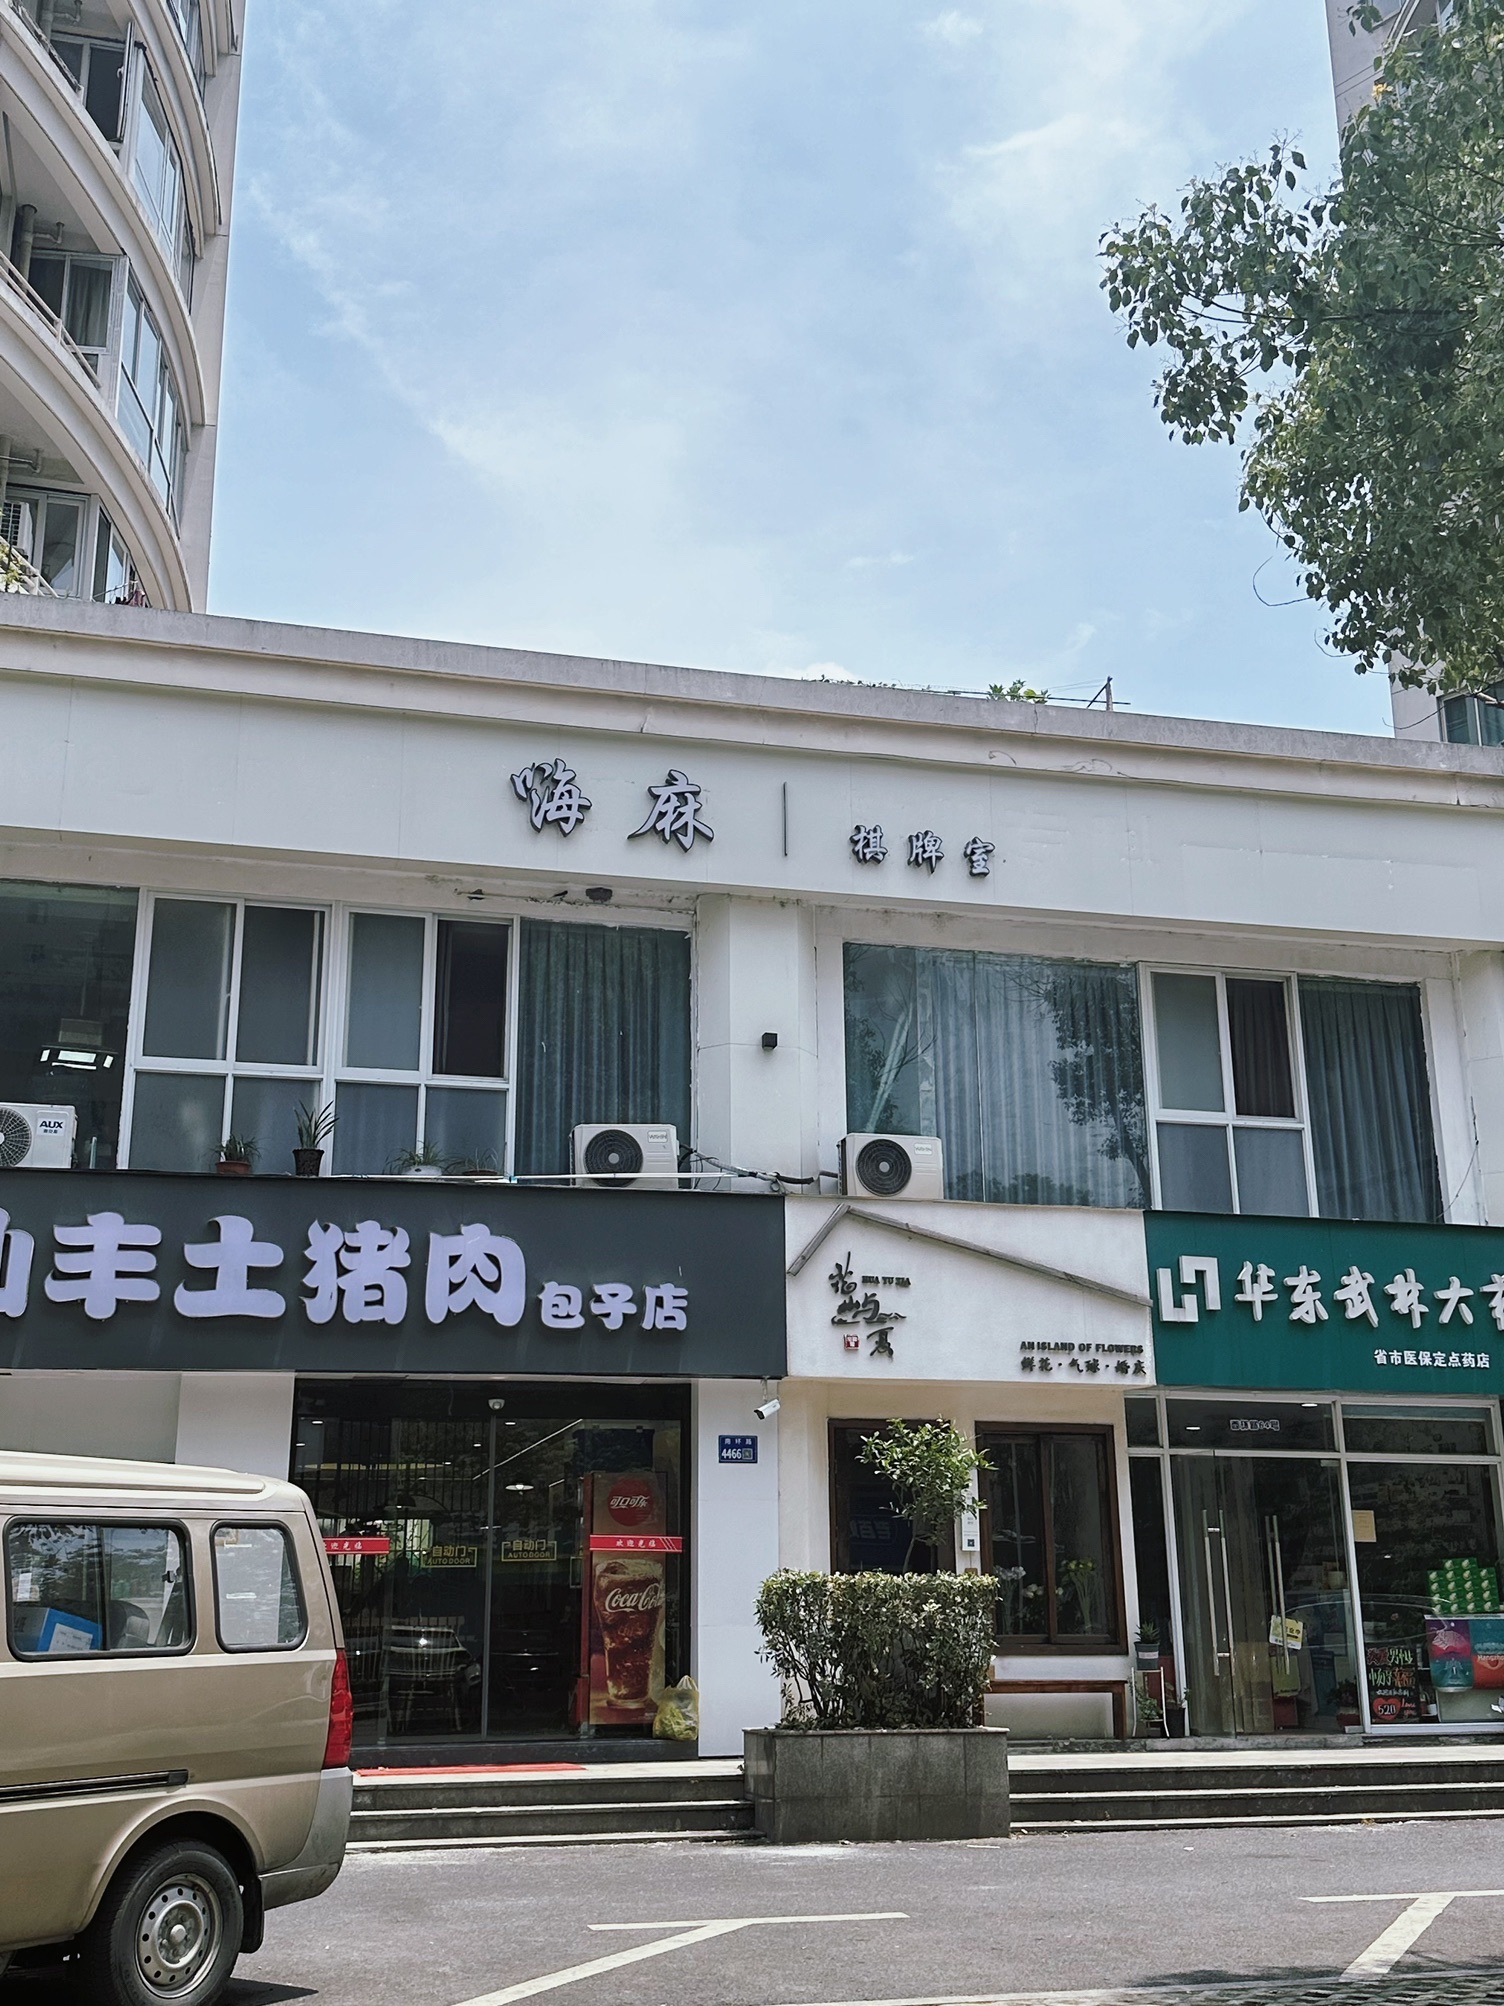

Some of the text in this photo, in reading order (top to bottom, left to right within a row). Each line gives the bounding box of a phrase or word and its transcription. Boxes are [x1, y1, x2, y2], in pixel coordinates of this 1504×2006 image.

[510, 758, 996, 878] 嗨麻 棋牌室
[39, 1120, 64, 1129] AUX
[538, 1281, 689, 1331] 包子店
[1020, 1341, 1144, 1354] AN ISLAND OF FLOWERS
[1374, 1349, 1490, 1369] 省市医保定点药店
[721, 1448, 742, 1459] 4466
[610, 1495, 650, 1509] 可口可乐
[512, 1539, 546, 1551] 自动门
[616, 1539, 656, 1548] 欢迎光临
[432, 1545, 467, 1557] 自动门
[1378, 1704, 1396, 1715] 520
